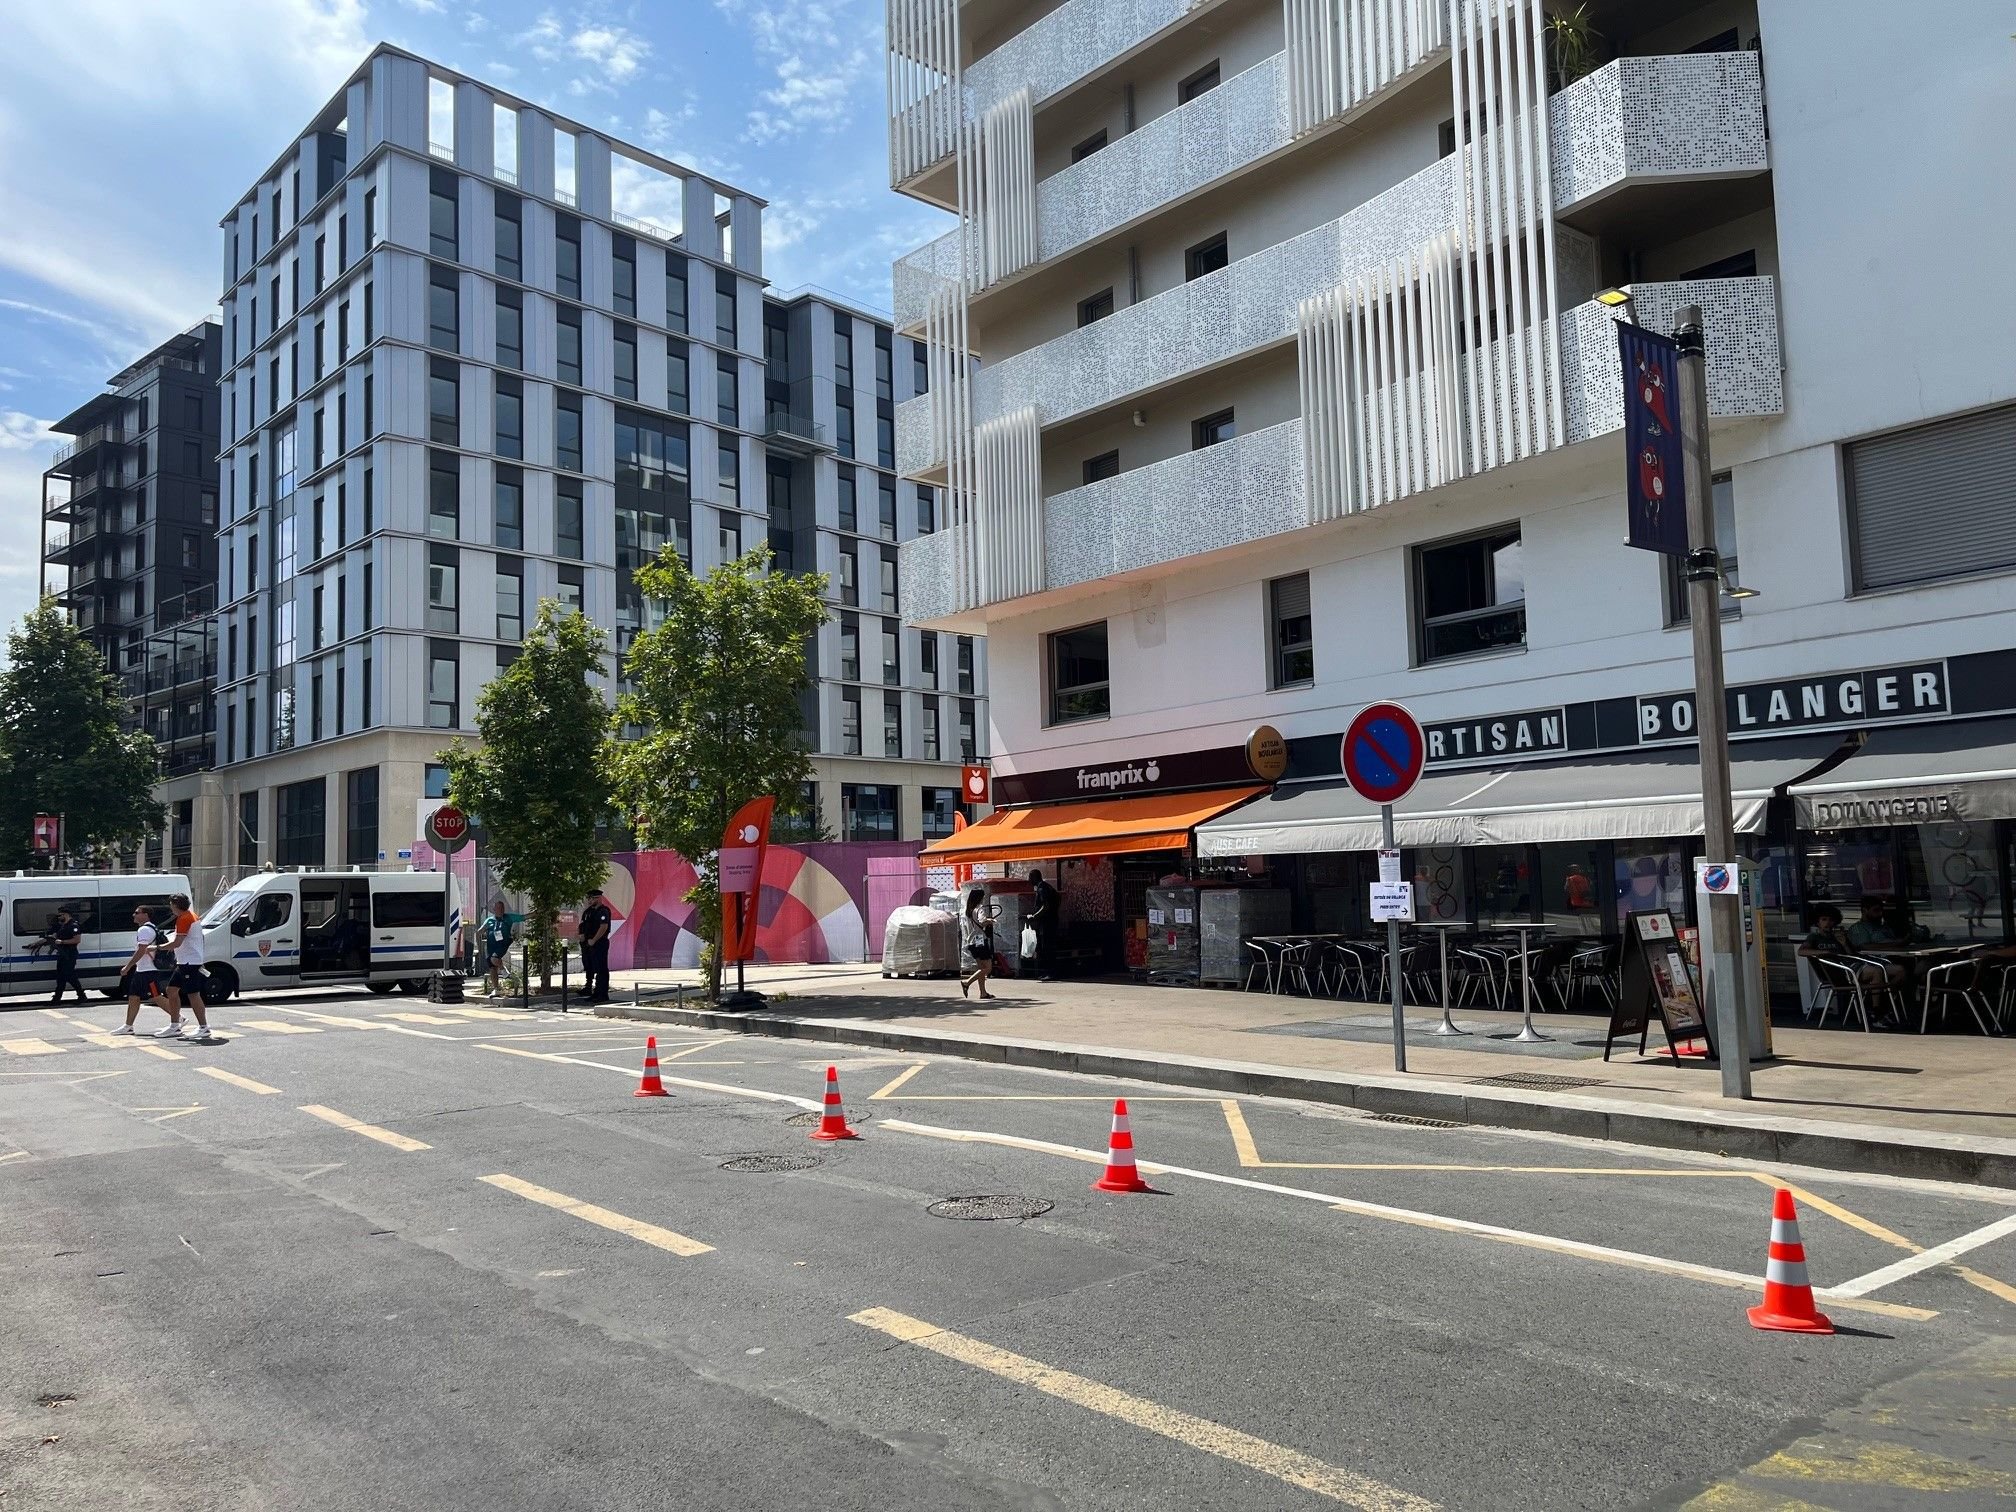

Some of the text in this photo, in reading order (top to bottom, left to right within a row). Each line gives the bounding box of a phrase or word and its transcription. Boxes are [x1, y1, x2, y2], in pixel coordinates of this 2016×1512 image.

[1428, 671, 1943, 758] RTISAN BOLANGER
[1076, 763, 1144, 790] franprix
[1815, 795, 1949, 822] BOULANGERIE
[436, 817, 463, 828] STOP
[1210, 838, 1234, 851] AUSE
[1741, 871, 1748, 884] P
